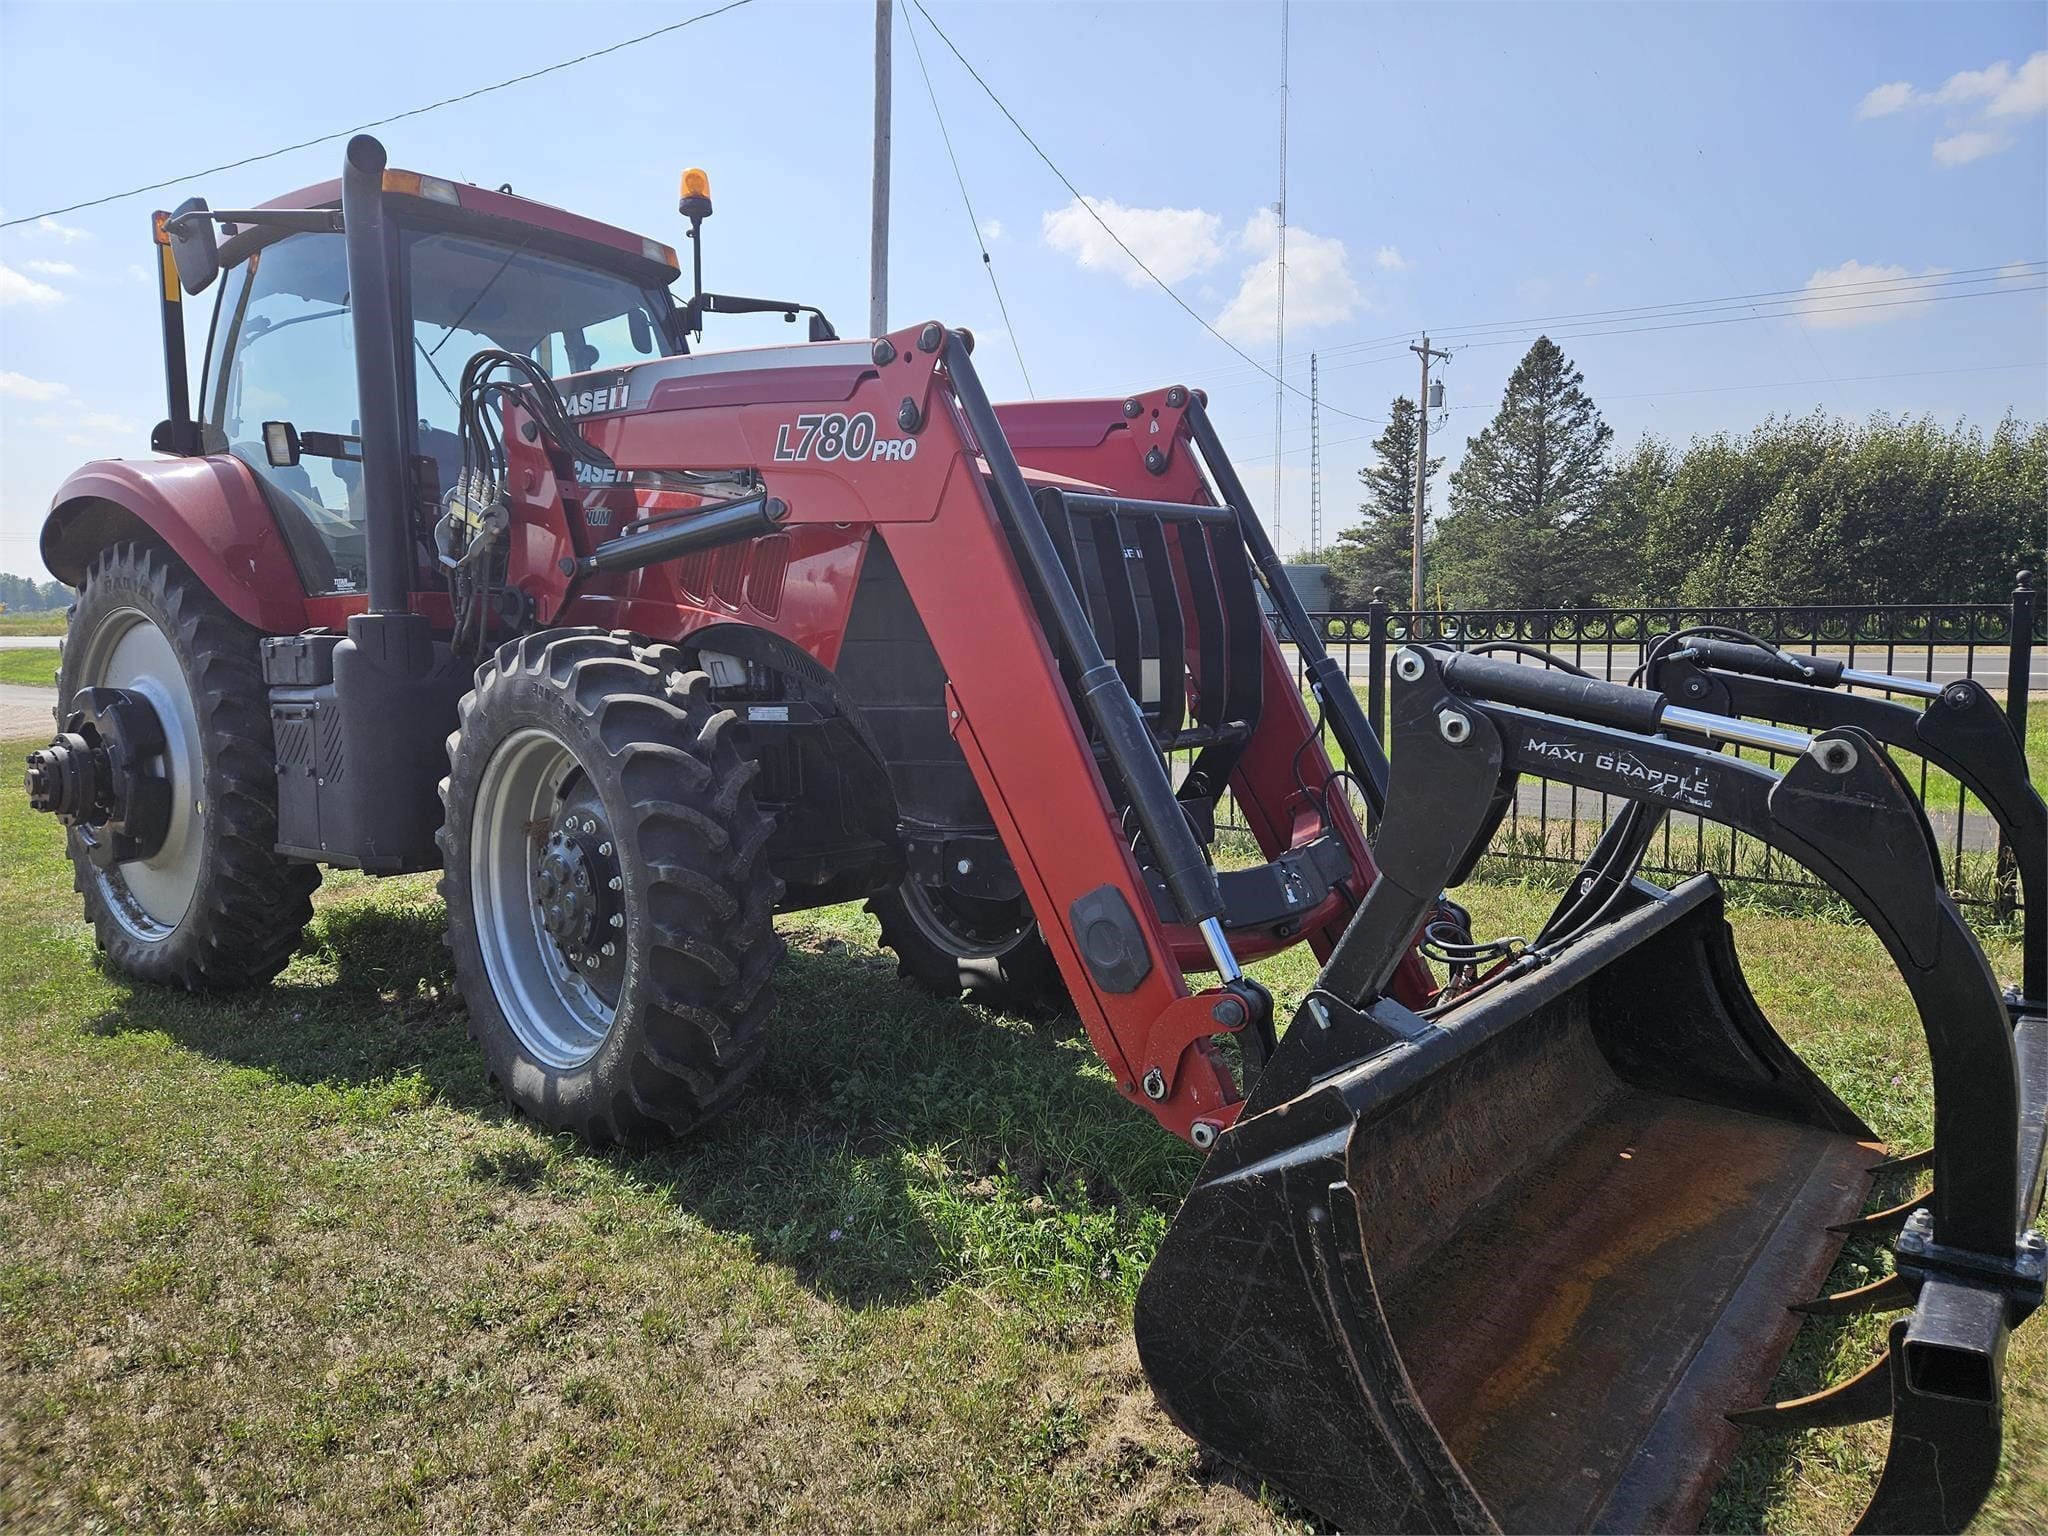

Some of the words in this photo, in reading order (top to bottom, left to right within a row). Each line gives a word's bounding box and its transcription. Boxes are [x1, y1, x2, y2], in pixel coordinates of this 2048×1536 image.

[774, 412, 876, 461] L780
[871, 438, 917, 462] PRO
[1527, 738, 1584, 764] MAXI
[1595, 755, 1710, 795] GRAPPLE
